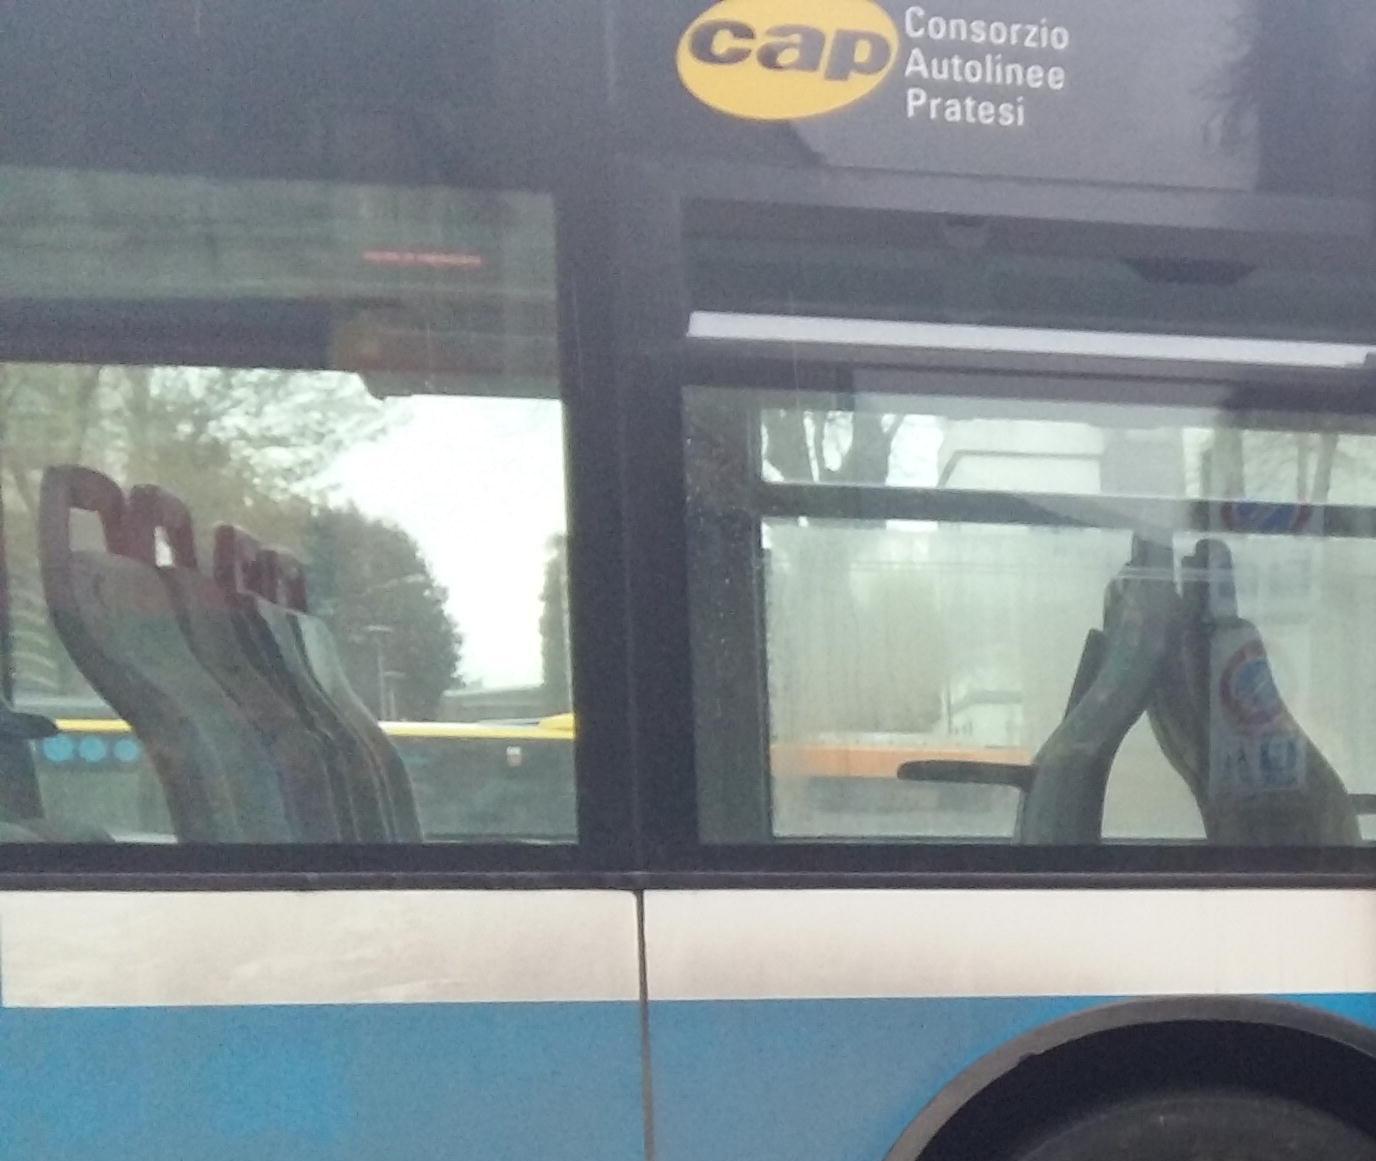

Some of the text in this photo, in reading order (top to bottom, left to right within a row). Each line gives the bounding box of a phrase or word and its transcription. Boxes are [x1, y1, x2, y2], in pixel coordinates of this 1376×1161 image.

[904, 6, 1069, 50] Consorzio
[687, 18, 892, 82] cap
[904, 49, 1066, 91] Autolinee
[906, 88, 1025, 127] Pratesi
